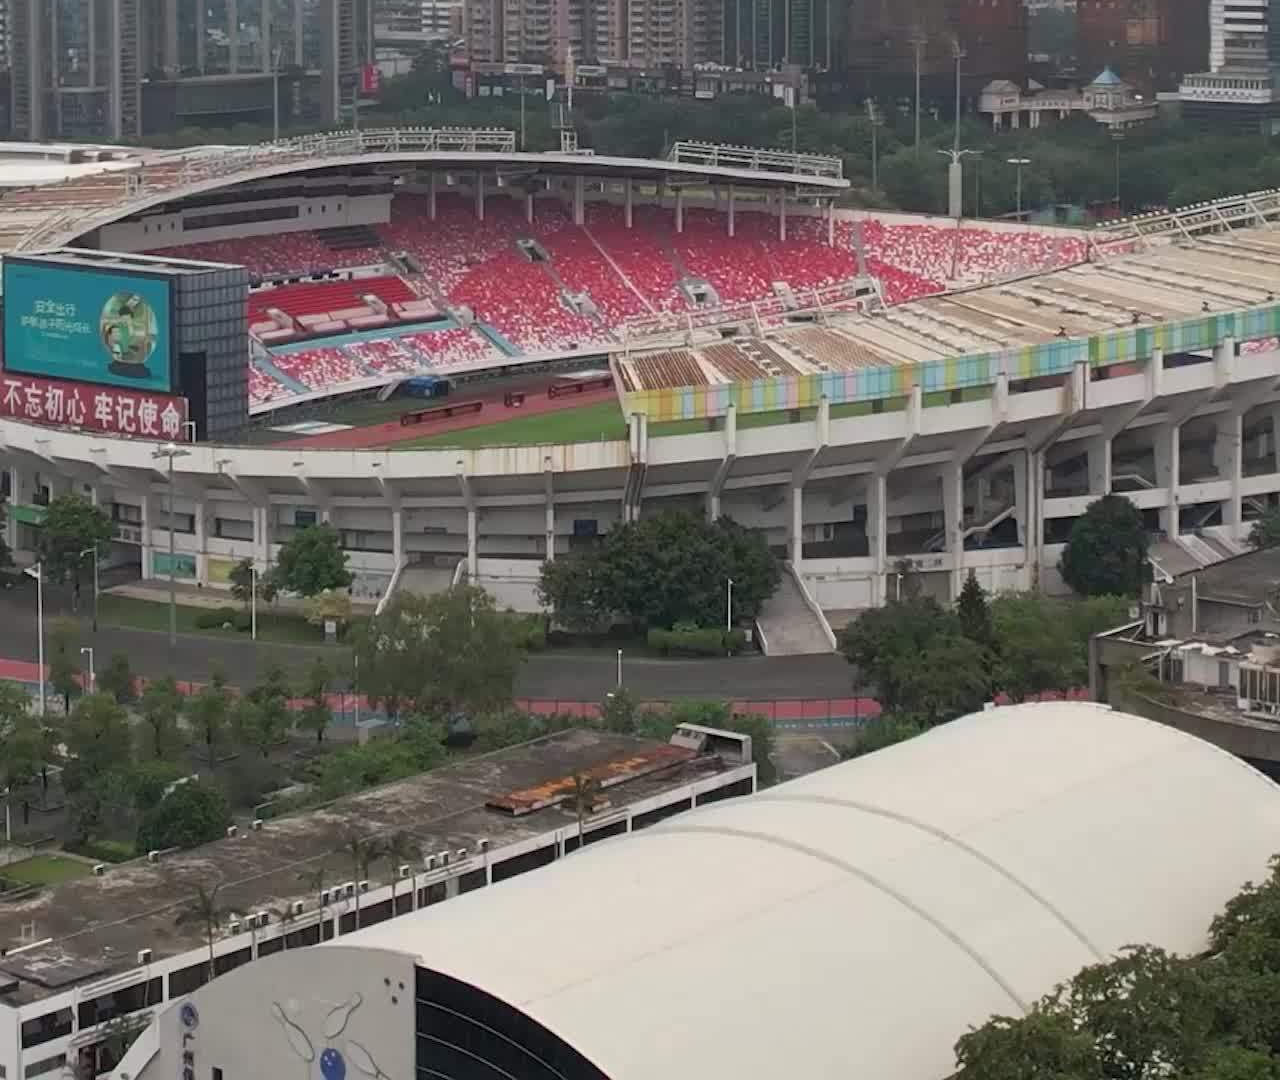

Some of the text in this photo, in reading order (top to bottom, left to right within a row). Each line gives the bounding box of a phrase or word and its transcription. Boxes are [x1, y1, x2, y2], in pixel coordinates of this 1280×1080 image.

[3, 379, 180, 439] 不忘初心 牢记使命
